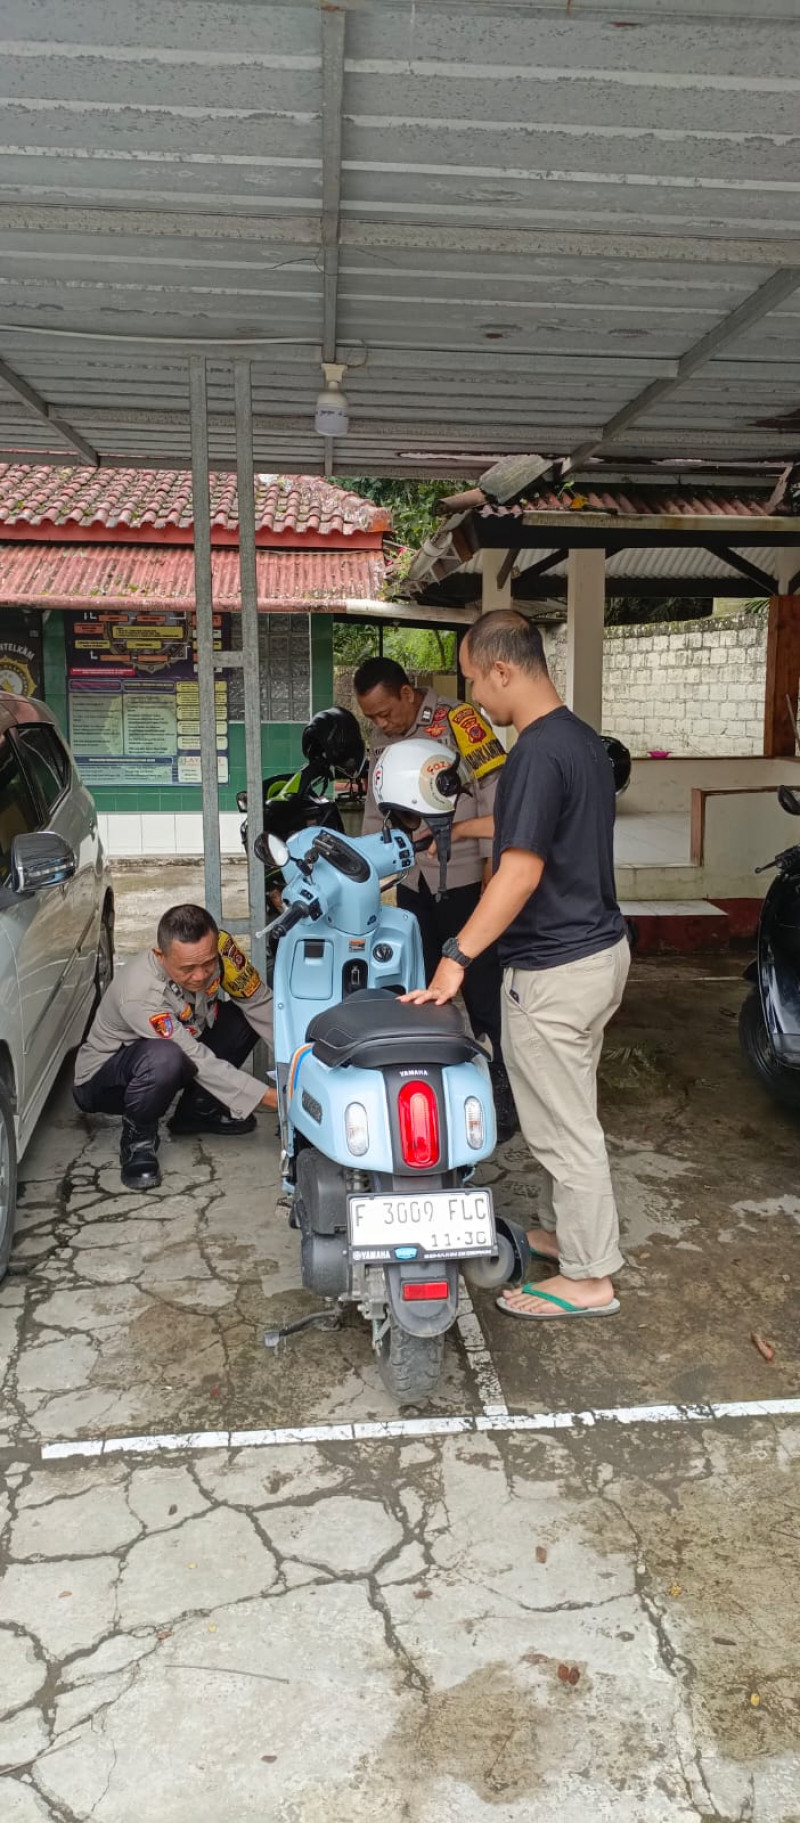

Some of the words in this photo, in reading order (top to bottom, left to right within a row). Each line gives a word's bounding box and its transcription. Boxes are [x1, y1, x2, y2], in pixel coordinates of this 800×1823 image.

[399, 1069, 428, 1077] YAMAHA
[355, 1204, 366, 1227] F
[382, 1201, 434, 1225] 3009
[448, 1198, 487, 1221] FLC
[362, 1250, 391, 1259] YAMAHA
